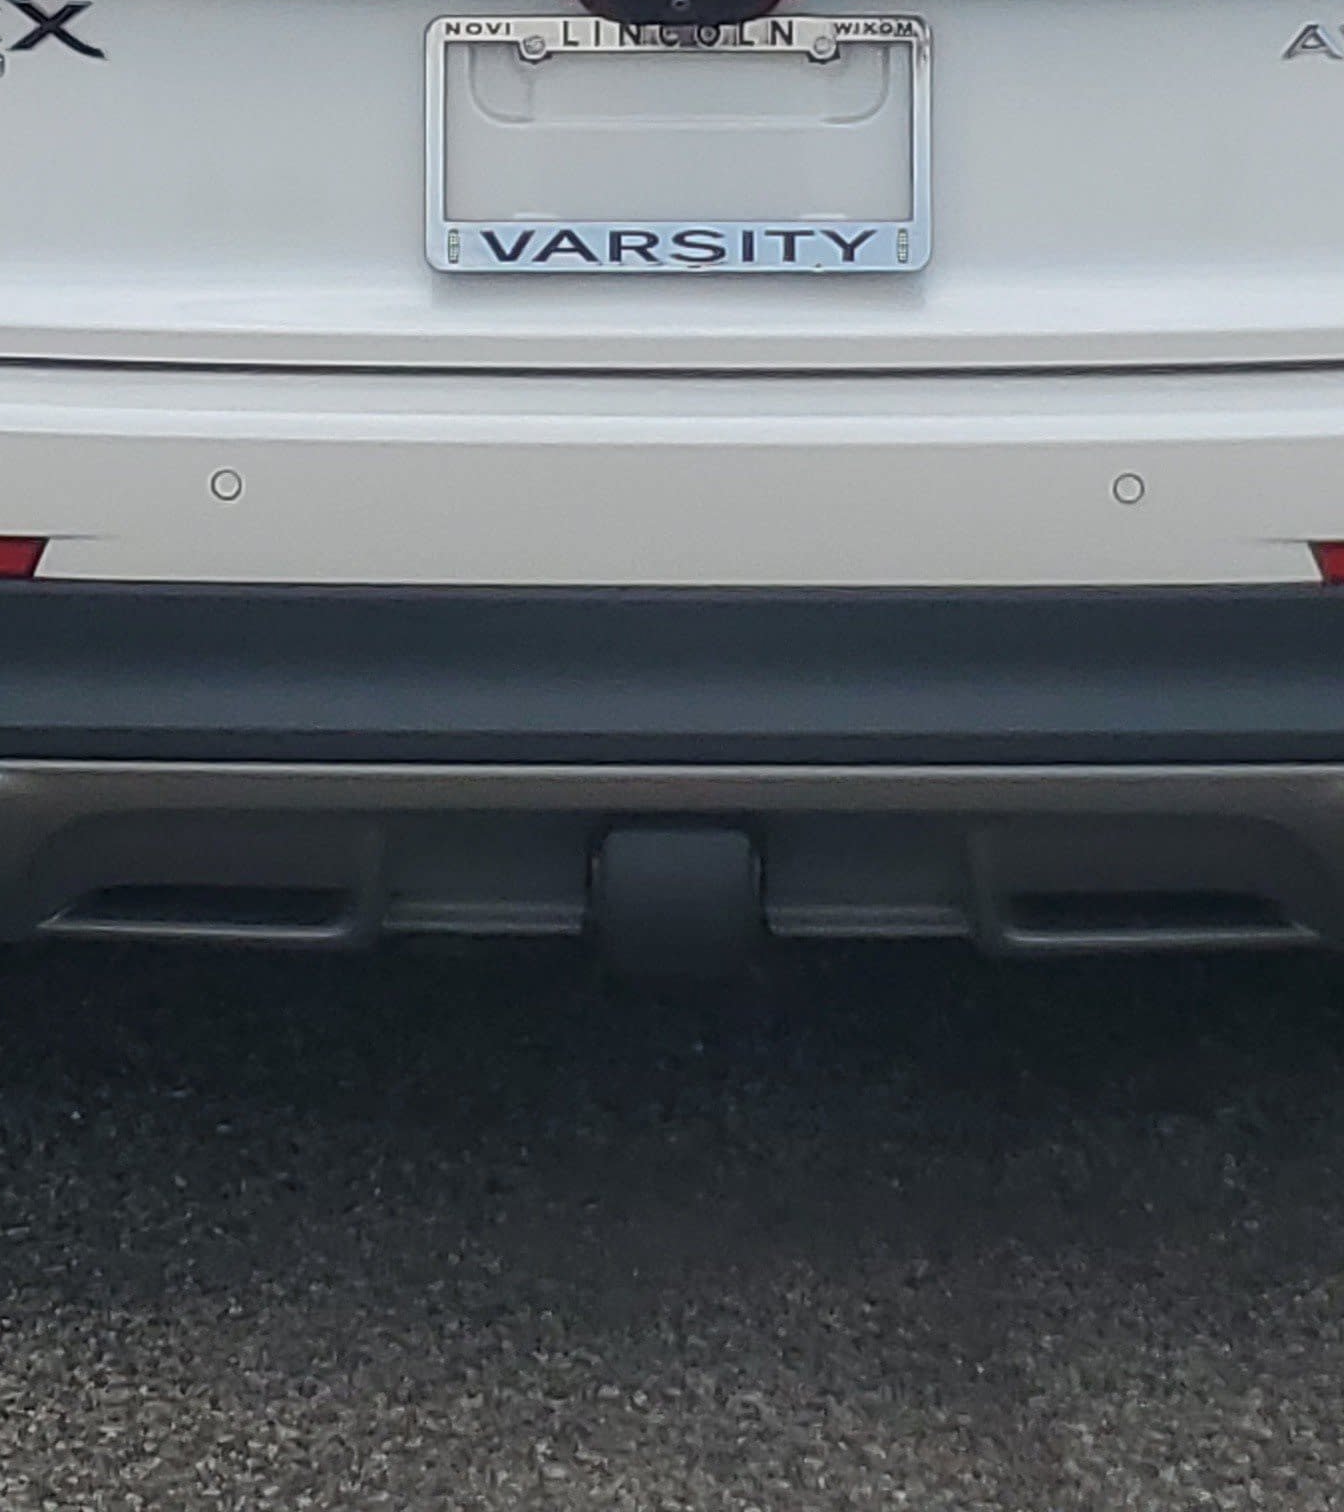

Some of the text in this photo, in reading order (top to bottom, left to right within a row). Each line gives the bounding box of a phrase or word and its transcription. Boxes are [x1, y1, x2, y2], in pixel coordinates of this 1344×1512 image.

[444, 21, 511, 36] NOVI
[562, 20, 794, 47] LINCOLN
[834, 21, 914, 37] WIXOM
[480, 228, 878, 264] VARSITY
